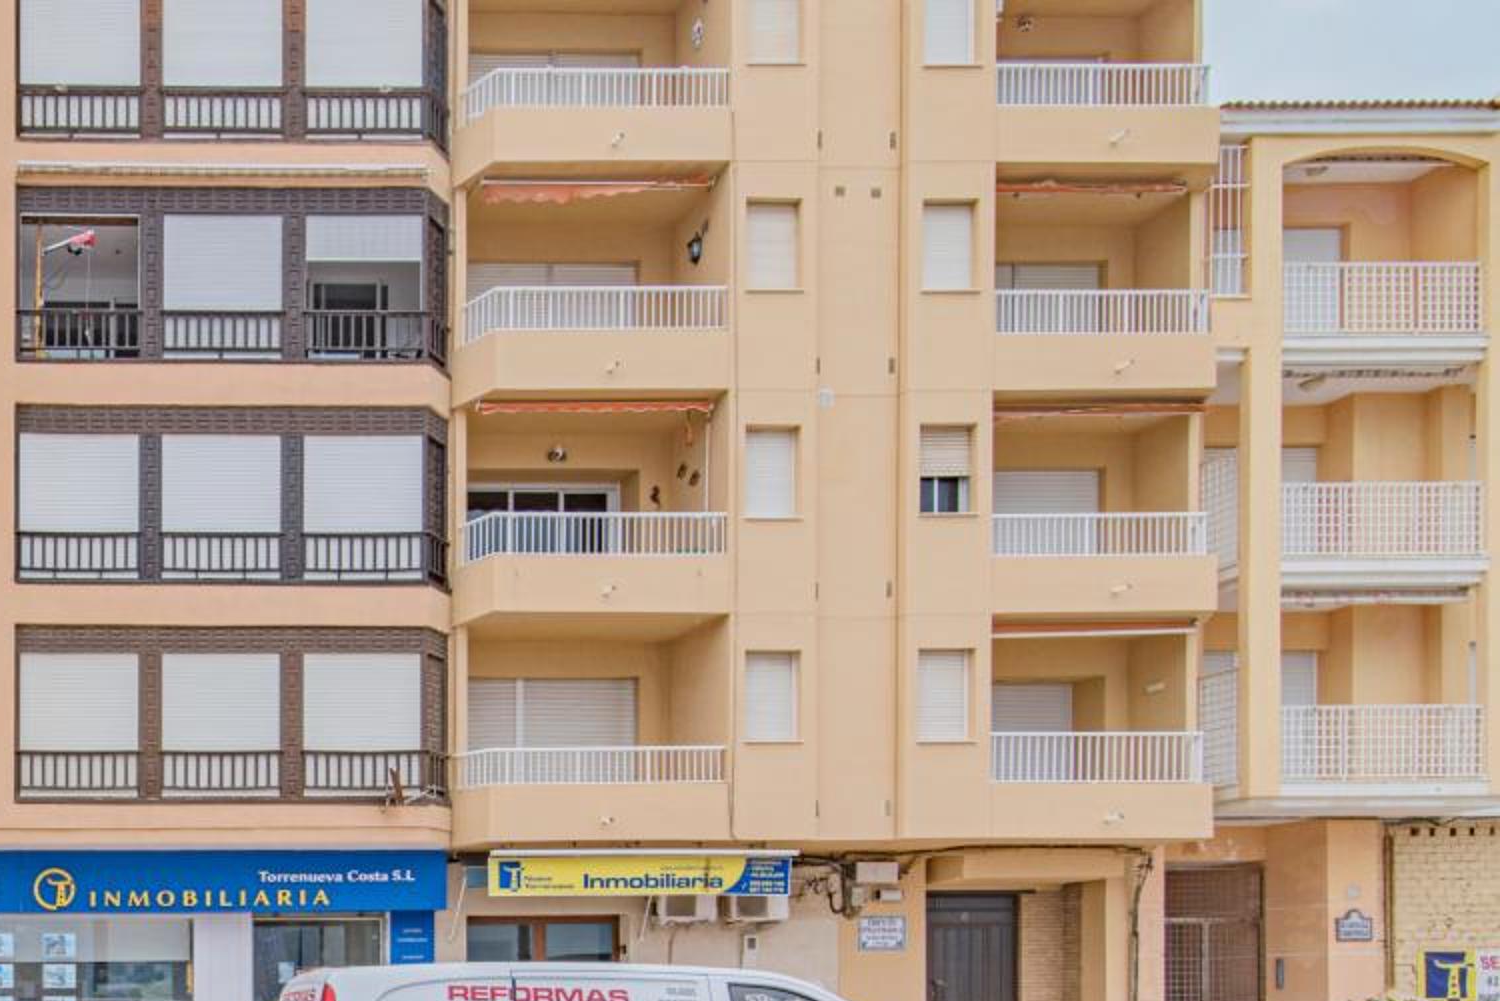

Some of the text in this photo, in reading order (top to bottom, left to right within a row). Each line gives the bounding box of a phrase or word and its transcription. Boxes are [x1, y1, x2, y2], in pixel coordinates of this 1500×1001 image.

[259, 871, 344, 883] Torrenueva
[347, 870, 389, 882] Costa
[583, 873, 723, 889] Inmobiliaria
[89, 890, 330, 907] INMOBILIARIA
